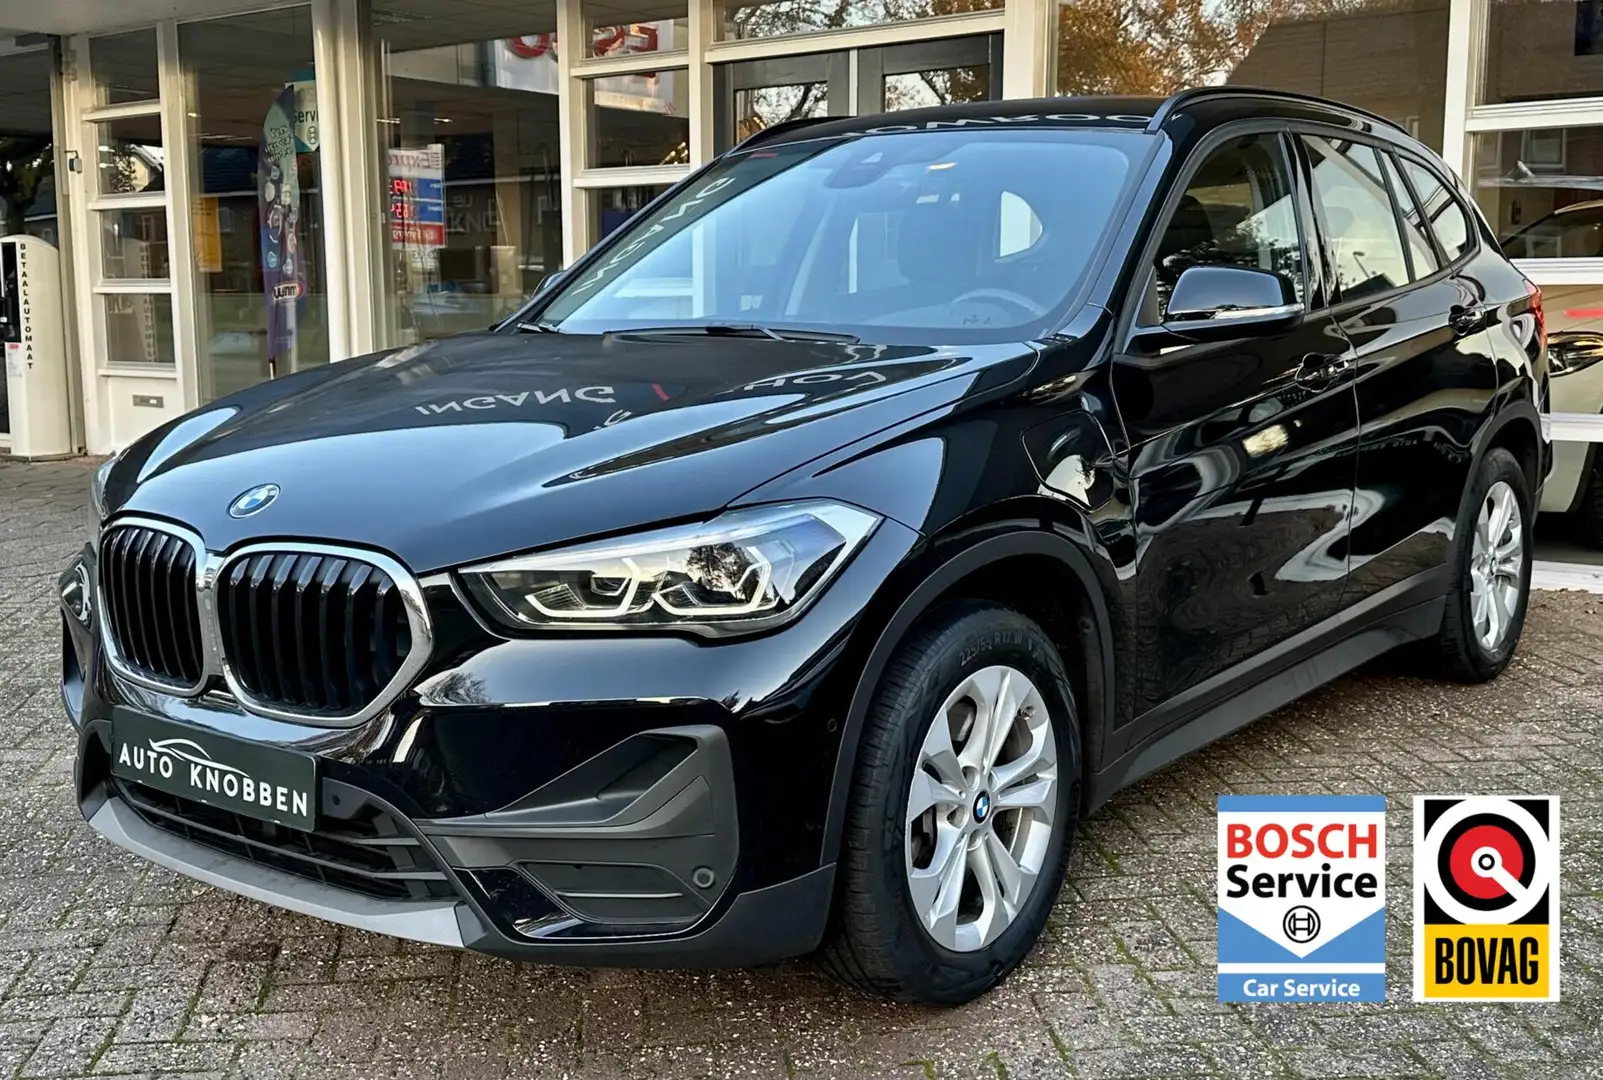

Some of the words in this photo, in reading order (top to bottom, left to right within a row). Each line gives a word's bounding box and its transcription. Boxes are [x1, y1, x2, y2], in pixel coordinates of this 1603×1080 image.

[20, 243, 34, 369] BETAALAUTOMAAT
[119, 742, 173, 778] AUTO
[190, 763, 307, 817] KNOBBEN
